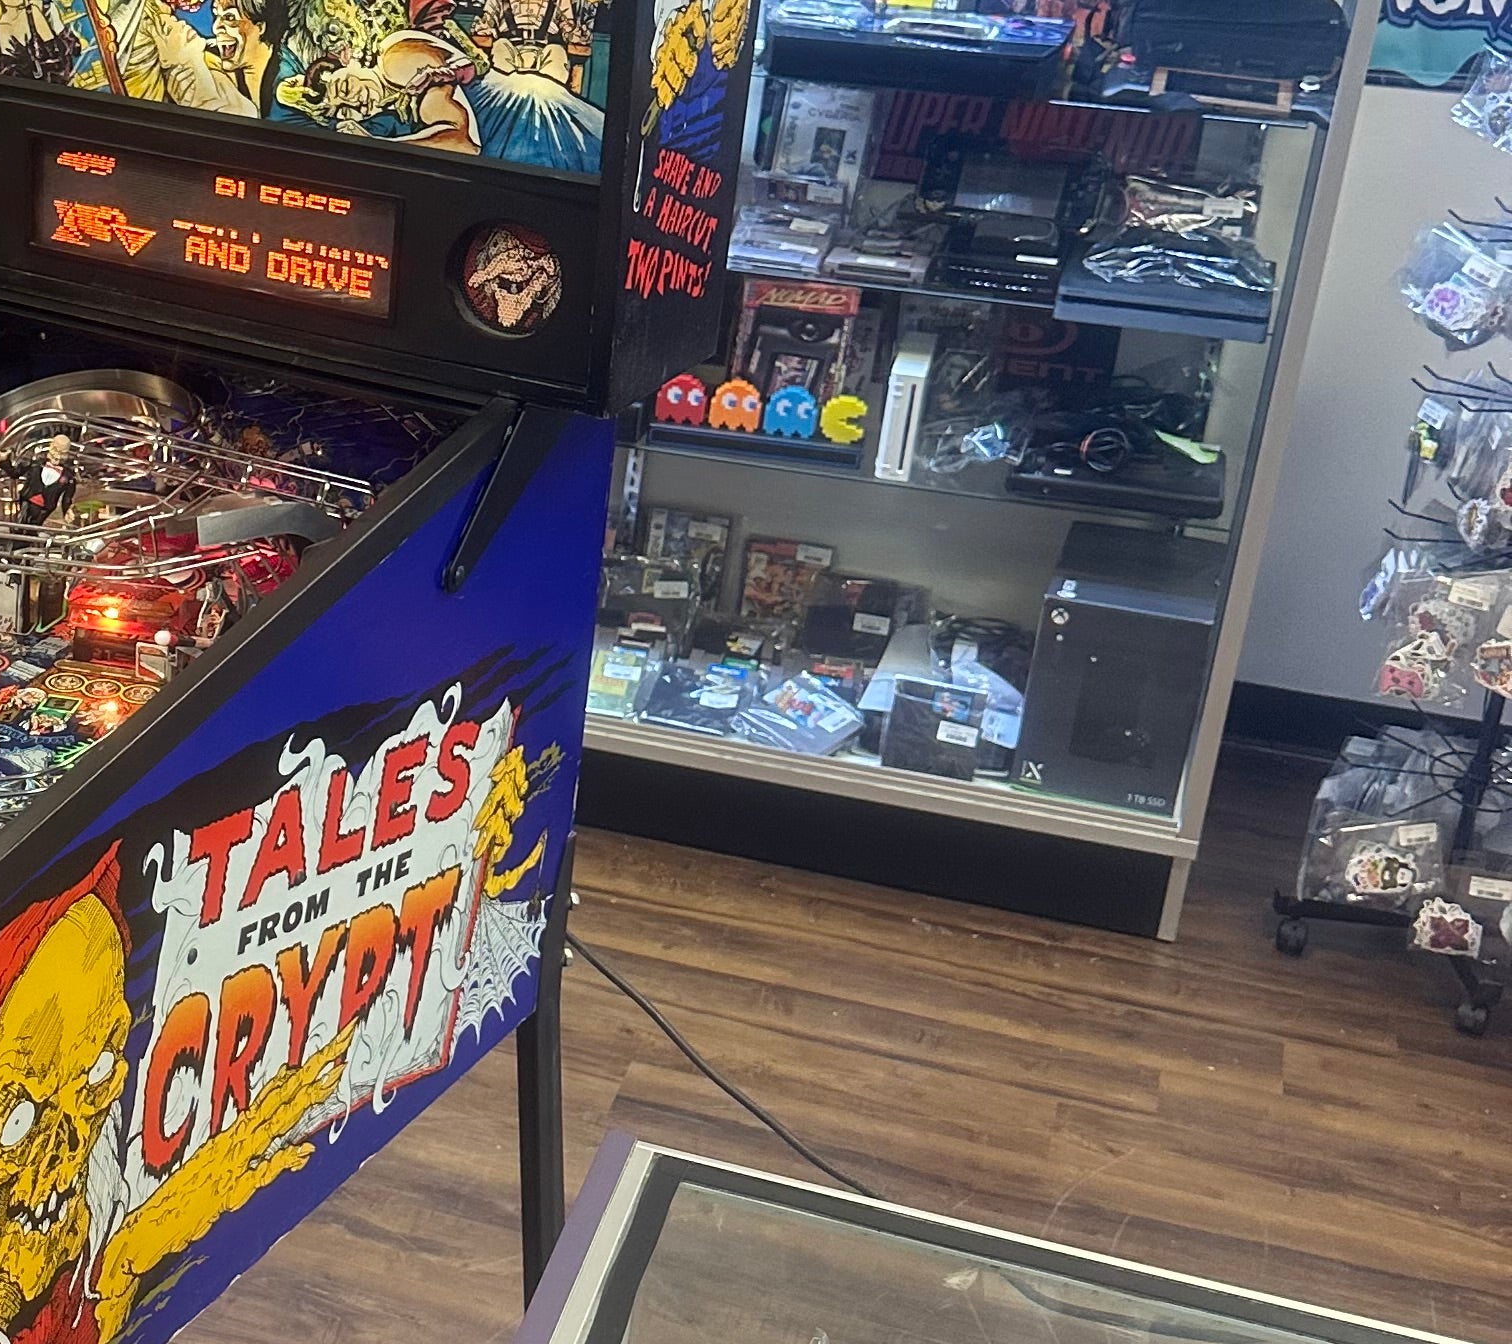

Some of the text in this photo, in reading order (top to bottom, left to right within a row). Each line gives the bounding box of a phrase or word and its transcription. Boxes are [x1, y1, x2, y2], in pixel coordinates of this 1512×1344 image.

[643, 186, 658, 218] A
[653, 148, 723, 199] SHAVE AND
[184, 235, 252, 274] AND
[266, 250, 373, 299] DRIVE
[624, 237, 713, 300] TWO PINTS!
[760, 285, 849, 309] NOMAD
[189, 721, 478, 927] TALES
[237, 855, 411, 956] FROM THE
[138, 867, 462, 1177] CRYPT
